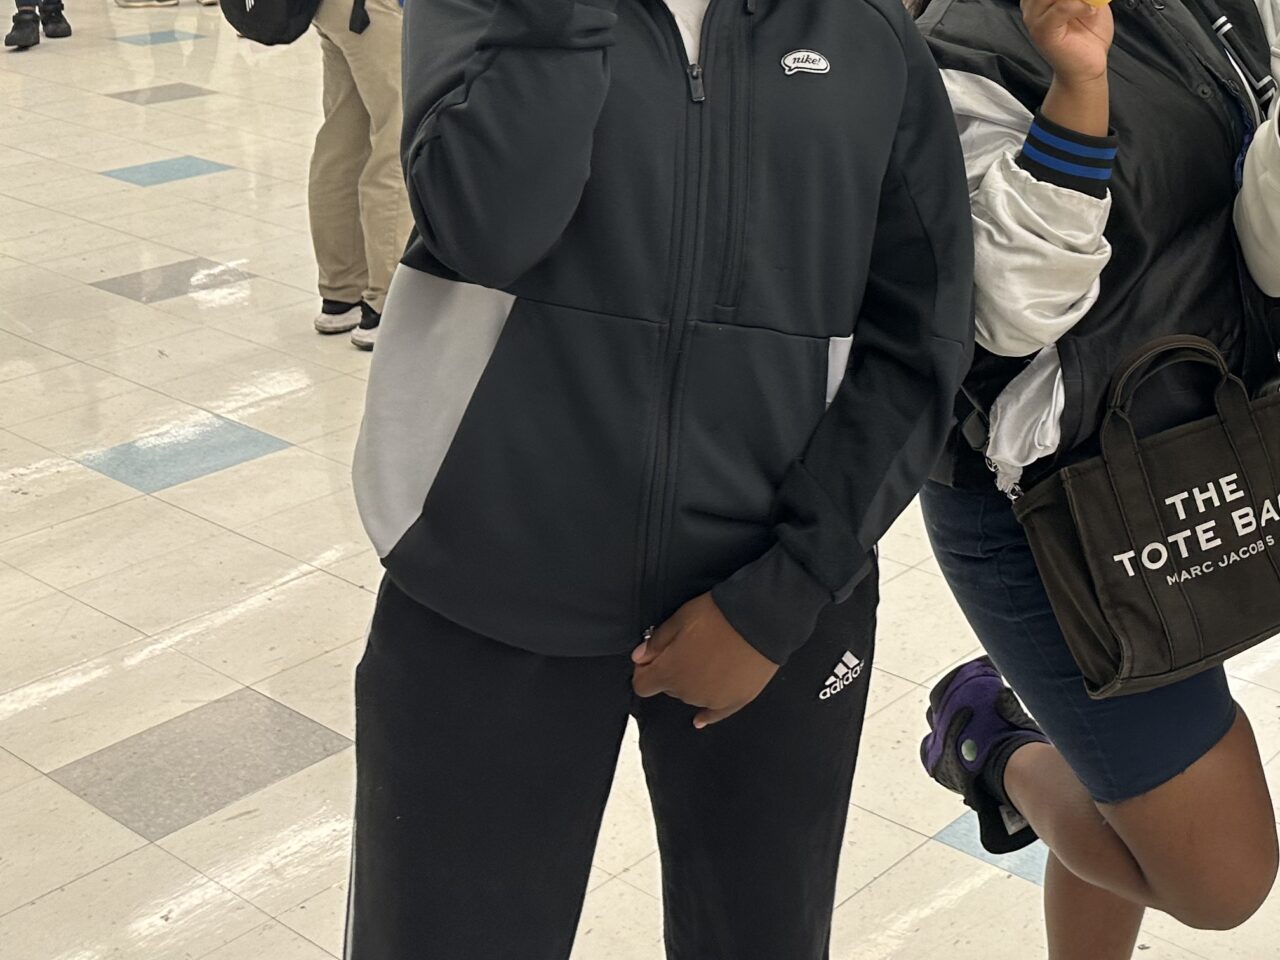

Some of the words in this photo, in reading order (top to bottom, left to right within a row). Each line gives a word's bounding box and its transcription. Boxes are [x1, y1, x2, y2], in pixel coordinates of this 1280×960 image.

[1165, 473, 1245, 520] THE
[1113, 520, 1222, 577] TOTE
[1166, 561, 1214, 585] MARC
[1218, 535, 1275, 567] JACOBS
